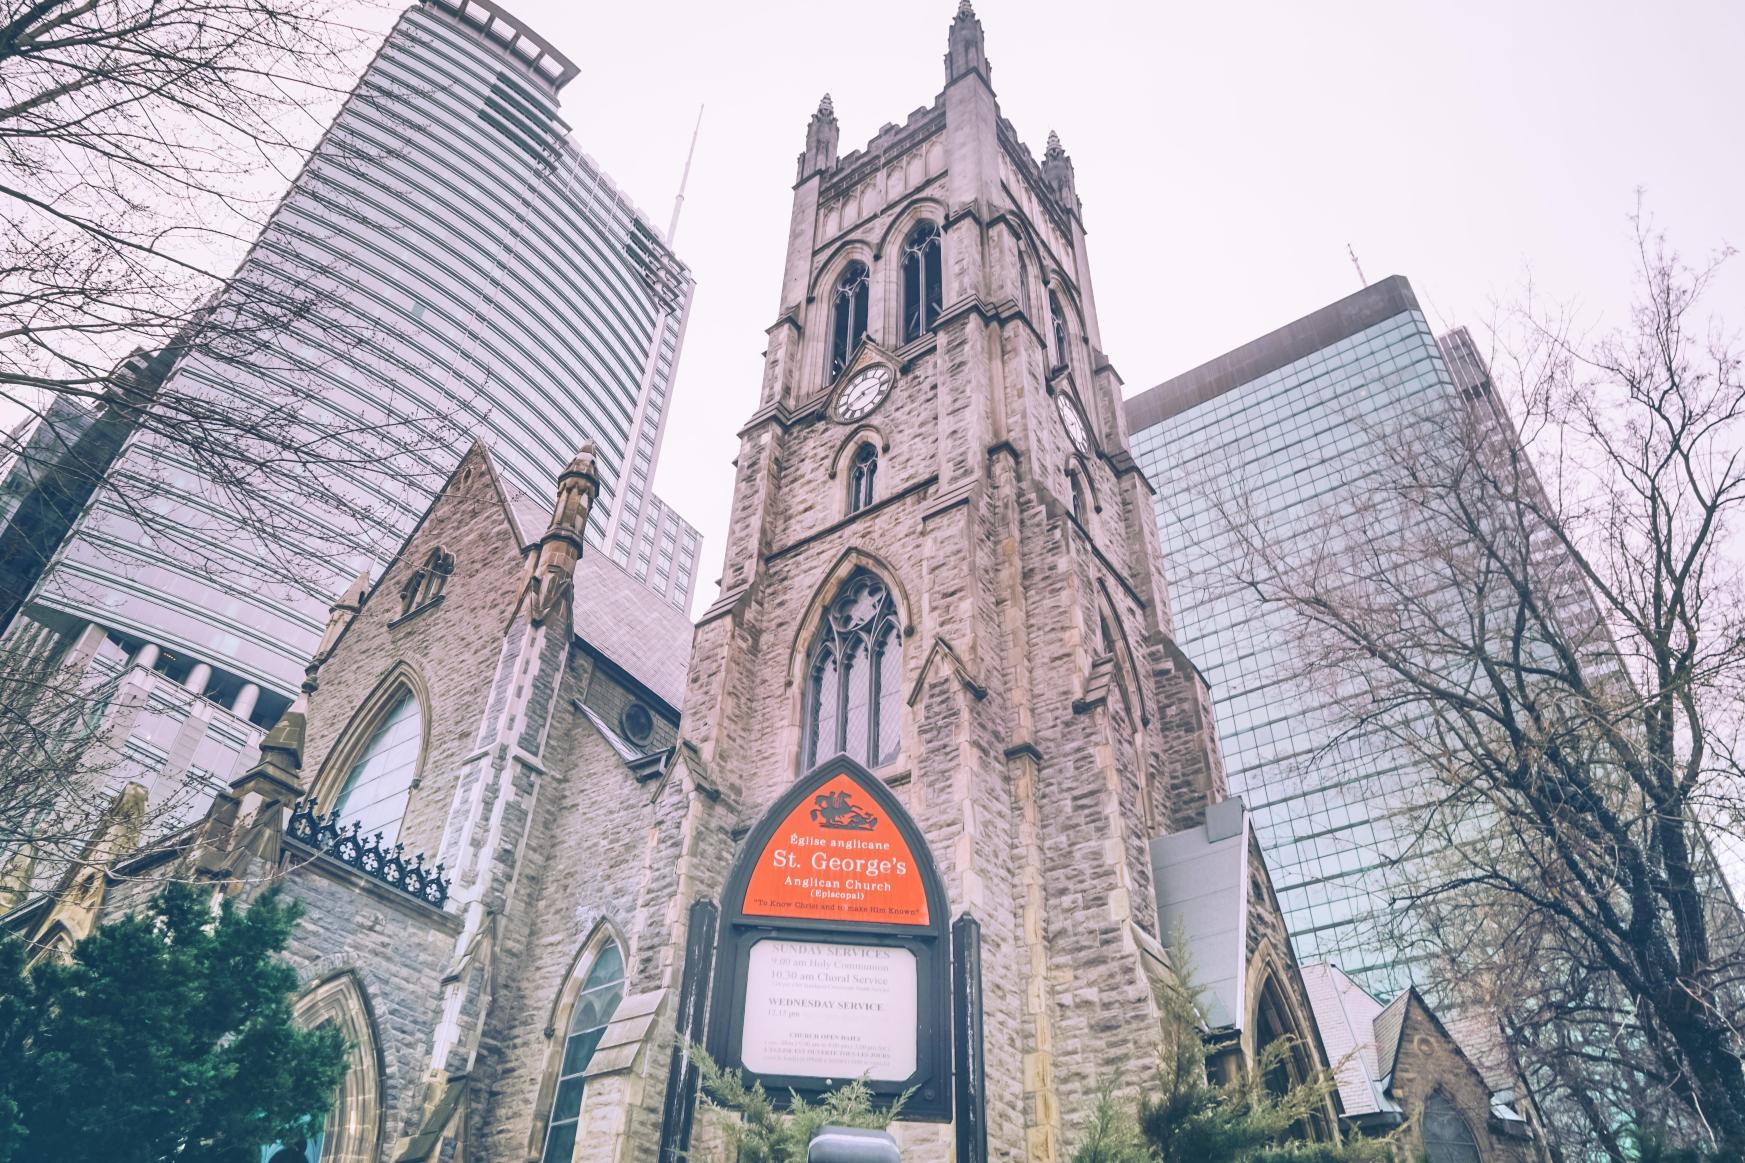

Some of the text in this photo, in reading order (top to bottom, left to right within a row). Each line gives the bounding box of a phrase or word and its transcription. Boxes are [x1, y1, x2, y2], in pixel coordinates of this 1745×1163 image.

[789, 833, 890, 851] Église anglicane
[773, 849, 907, 877] St. George's
[784, 876, 891, 892] Anglican Church
[810, 890, 865, 900] (Episcopal)
[769, 900, 792, 908] Know
[820, 903, 835, 911] and
[772, 943, 891, 959] SUNDAY SERVICES
[809, 958, 831, 970] Holy
[800, 973, 814, 981] am
[817, 972, 850, 982] Choral
[852, 974, 888, 986] Service
[768, 997, 883, 1012] WEDNESDAY SERVICE
